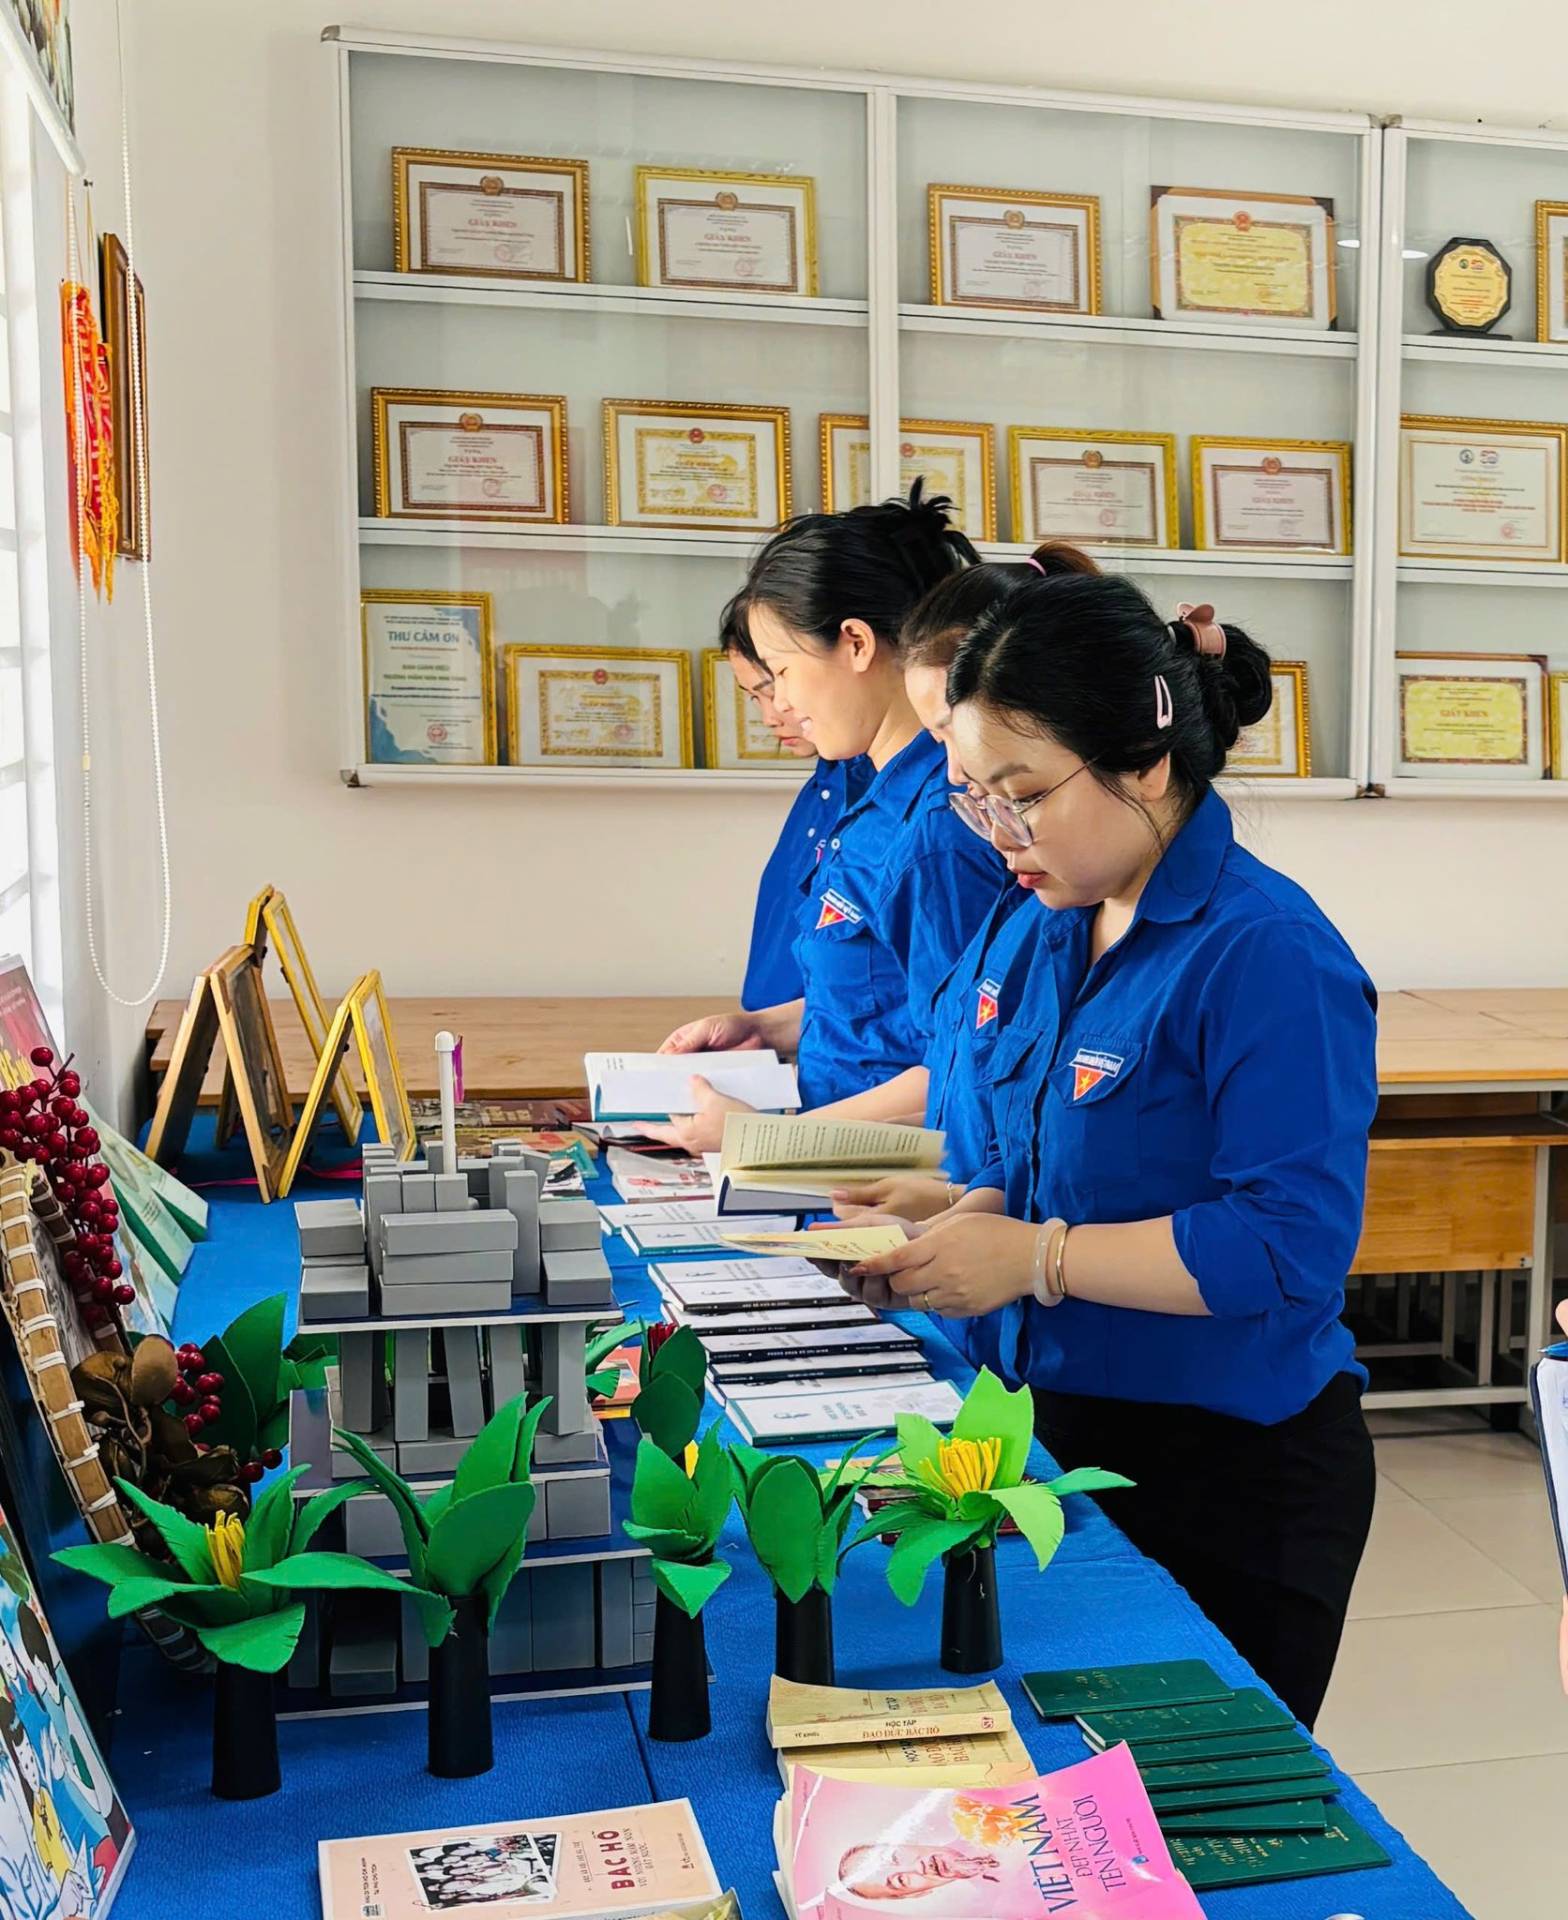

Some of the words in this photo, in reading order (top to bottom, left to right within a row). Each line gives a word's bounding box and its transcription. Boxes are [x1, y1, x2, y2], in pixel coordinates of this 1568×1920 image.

[413, 628, 440, 643] CẢM
[1009, 1793, 1060, 1857] NAM
[1056, 1817, 1084, 1853] NHẤT
[1072, 1794, 1114, 1857] NGƯỜI
[1070, 1855, 1094, 1878] ĐẸP
[1093, 1857, 1127, 1893] TÊN
[1030, 1860, 1079, 1913] VIỆT
